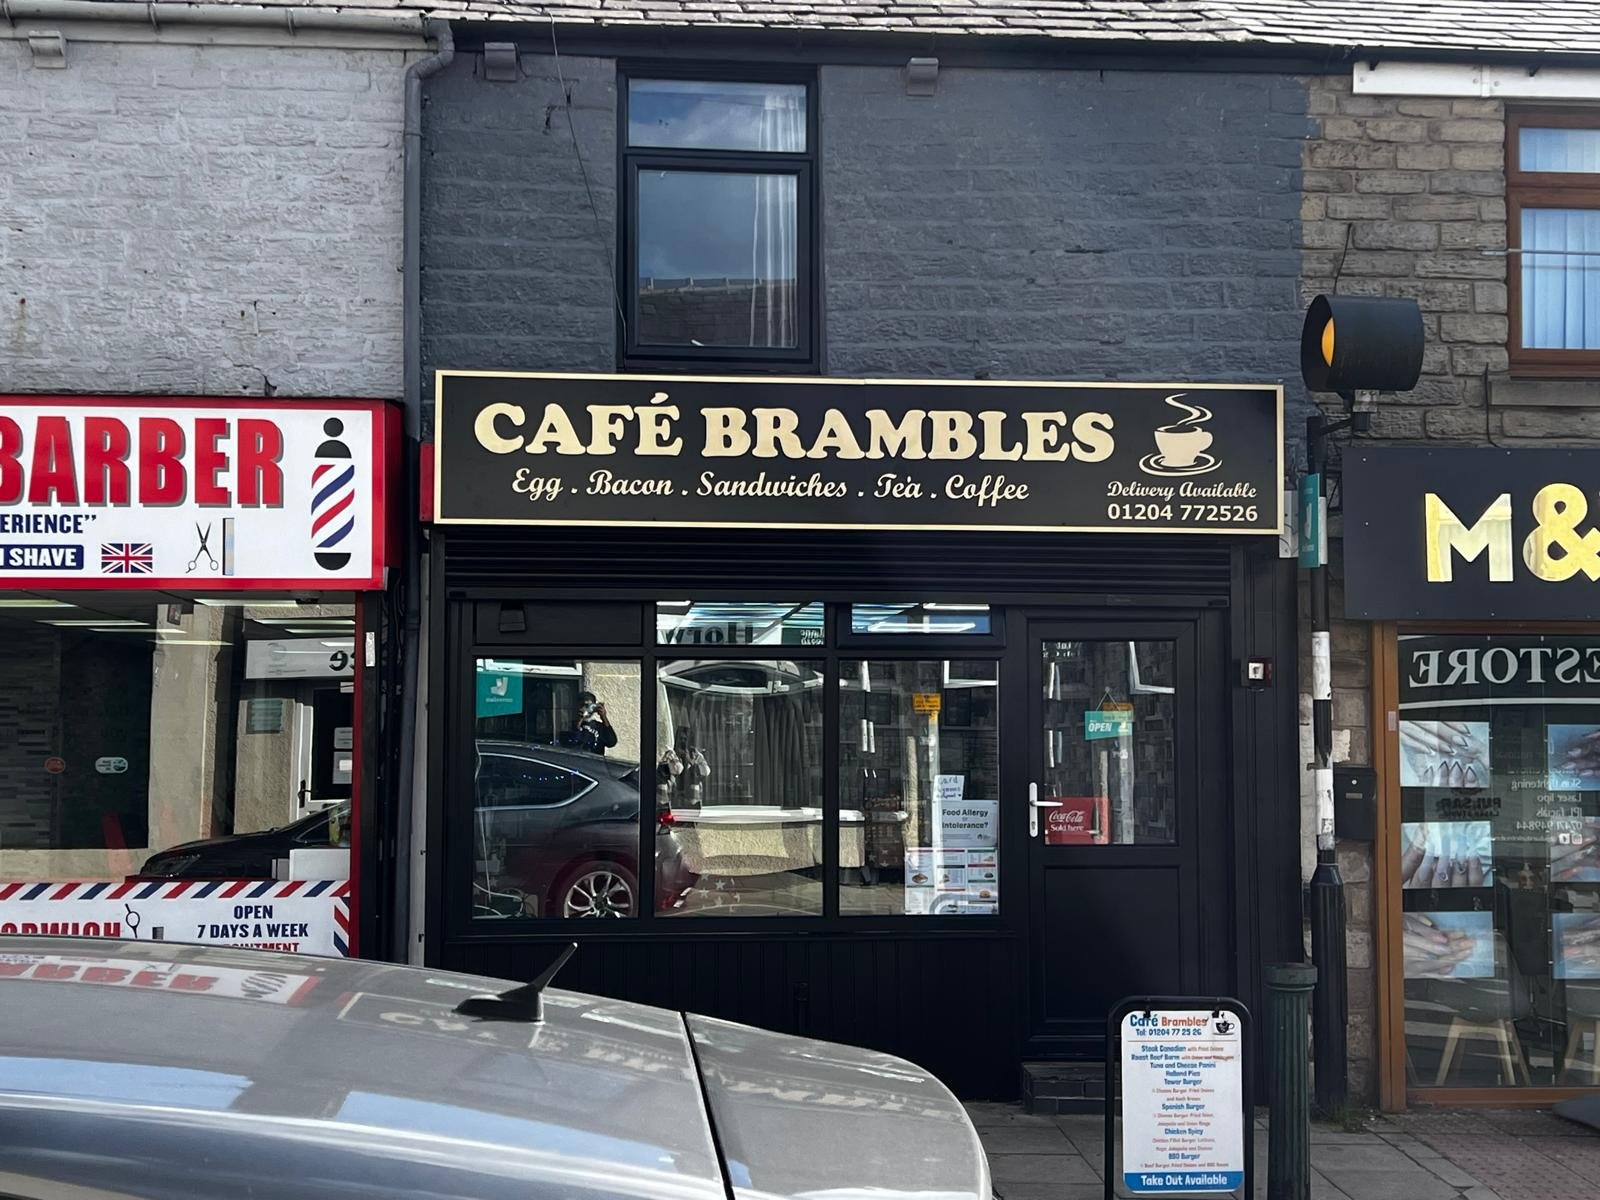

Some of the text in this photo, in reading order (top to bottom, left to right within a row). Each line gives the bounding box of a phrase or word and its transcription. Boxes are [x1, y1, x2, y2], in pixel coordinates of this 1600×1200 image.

[474, 392, 1115, 463] CAFÉ BRAMBLES
[512, 468, 563, 501] Egg
[586, 469, 673, 496] Bacon
[697, 471, 847, 498] Sandwiches
[945, 474, 1030, 507] Coffee
[1107, 481, 1257, 502] Delivery Available
[1107, 503, 1258, 522] 01204 772526
[9, 548, 77, 567] SHAVE
[1088, 722, 1113, 733] OPEN
[962, 809, 989, 817] Allergy
[1050, 824, 1084, 832] Sold here
[233, 904, 274, 920] OPEN
[198, 923, 309, 939] 7 DAYS A WEEK
[1161, 1016, 1208, 1027] Brambles
[1148, 1028, 1170, 1036] 01204
[1171, 1028, 1180, 1036] 77
[1183, 1078, 1203, 1086] Burger
[1162, 1103, 1205, 1111] Spanish Burger
[1188, 1128, 1204, 1136] Spicy
[1180, 1153, 1200, 1161] Burger
[1140, 1173, 1228, 1186] Take Out Available
